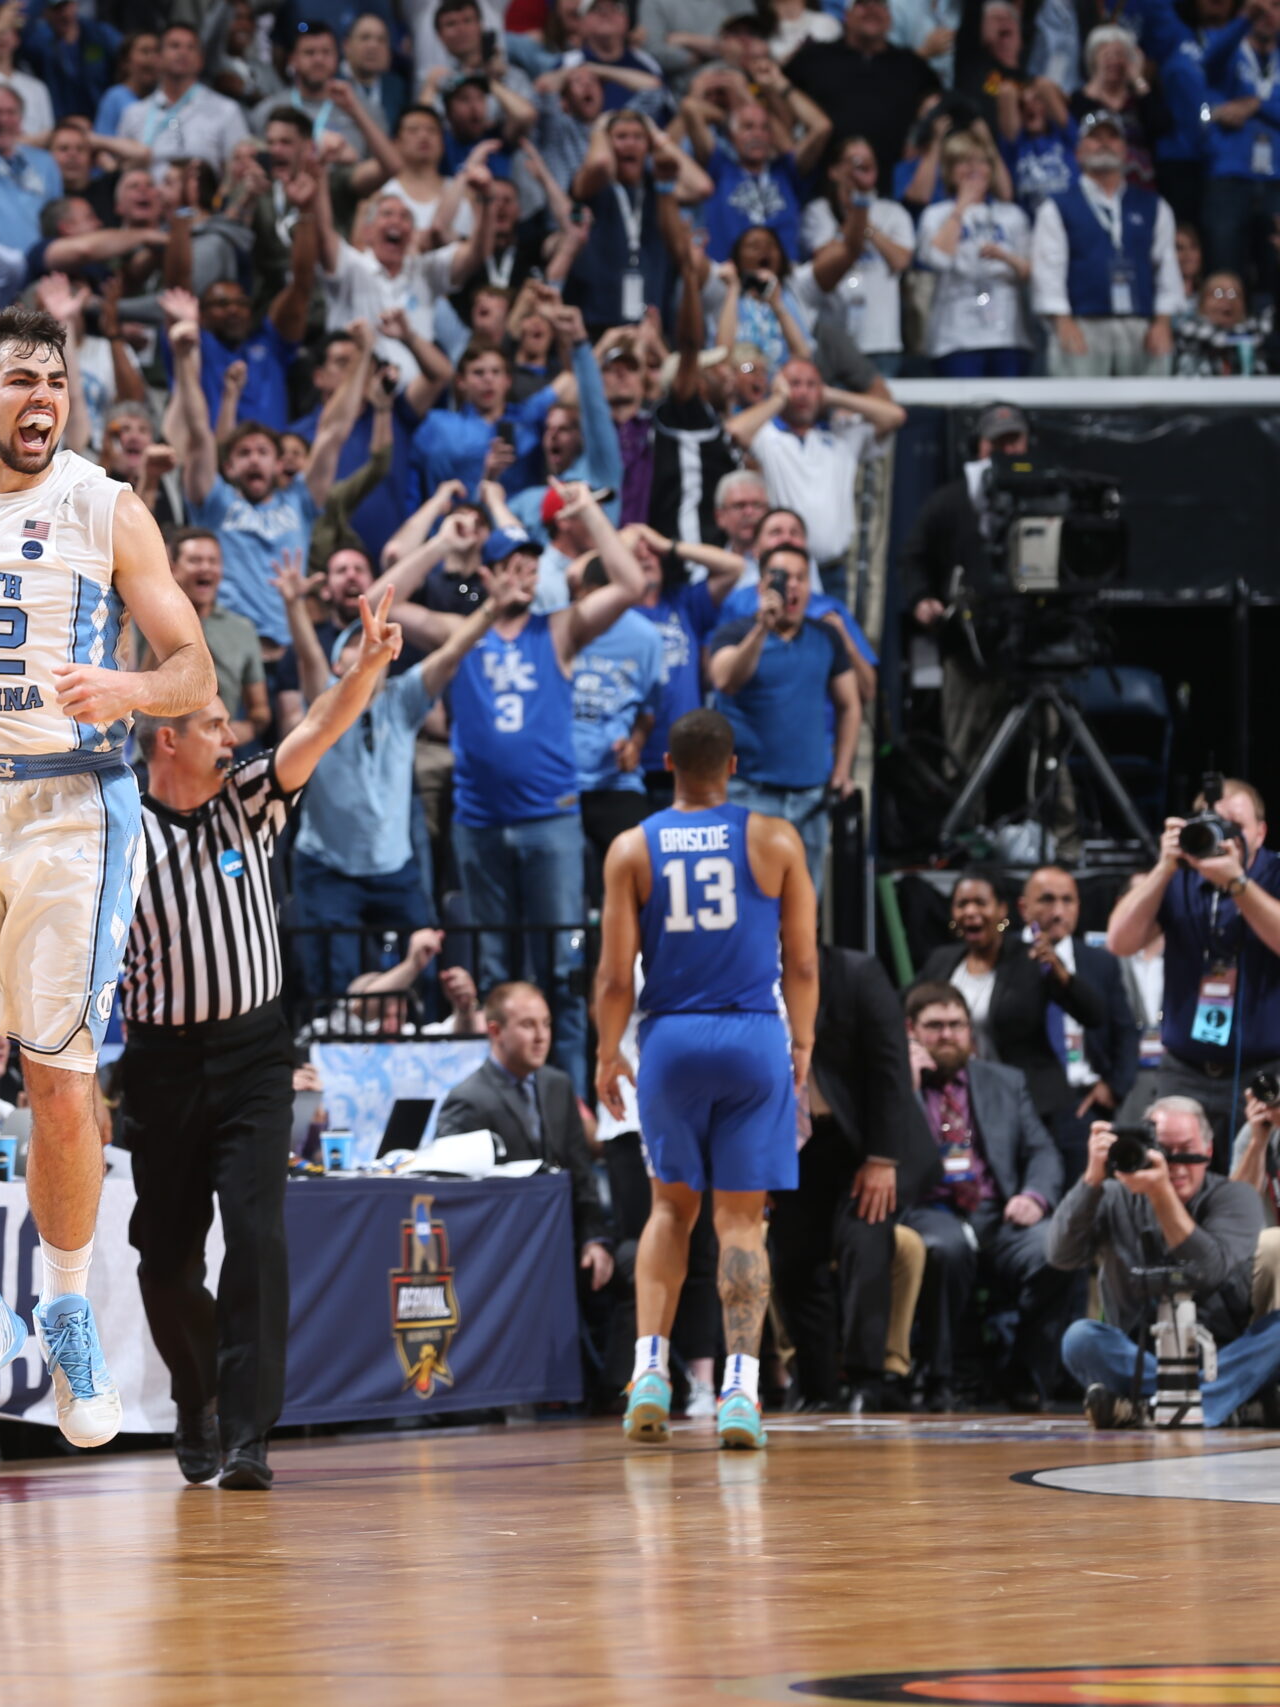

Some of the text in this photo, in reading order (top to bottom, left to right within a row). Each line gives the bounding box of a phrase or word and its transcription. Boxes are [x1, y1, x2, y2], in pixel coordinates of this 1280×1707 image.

[494, 693, 524, 733] 3
[660, 824, 730, 853] BRISCOE
[663, 857, 738, 932] 13
